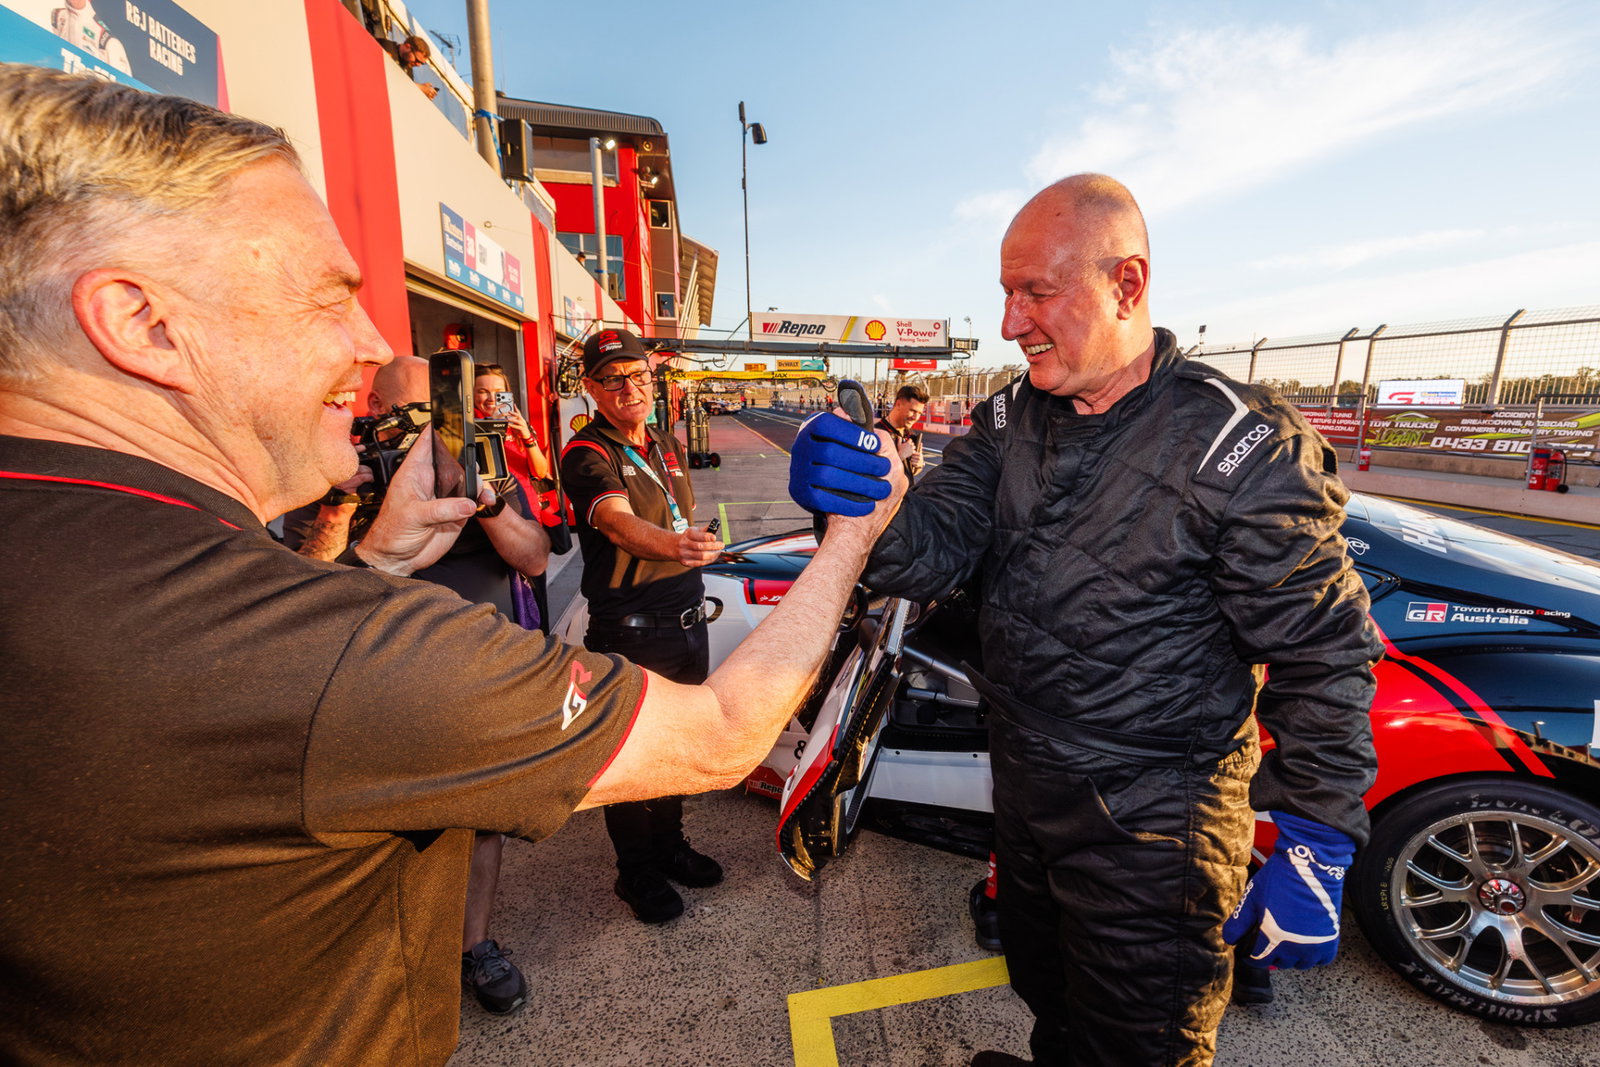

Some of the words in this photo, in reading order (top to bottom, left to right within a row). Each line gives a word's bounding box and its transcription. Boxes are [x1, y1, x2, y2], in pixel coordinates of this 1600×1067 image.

[125, 0, 147, 32] R&J
[148, 15, 196, 64] BATTERIES
[149, 38, 183, 76] RACING
[778, 320, 826, 337] Repco
[896, 320, 912, 328] Shell
[897, 328, 938, 337] V-Power
[995, 393, 1007, 429] sparco
[1394, 421, 1439, 429] TRUCKS
[1552, 429, 1594, 437] TOWING
[1217, 423, 1272, 476] sparco
[1430, 436, 1489, 451] 0433
[1407, 607, 1447, 622] GR
[1452, 605, 1494, 613] TOYOTA
[1496, 607, 1534, 615] GAZOO
[1535, 609, 1571, 619] Racing
[1450, 613, 1529, 625] Australia
[760, 781, 784, 794] Repc
